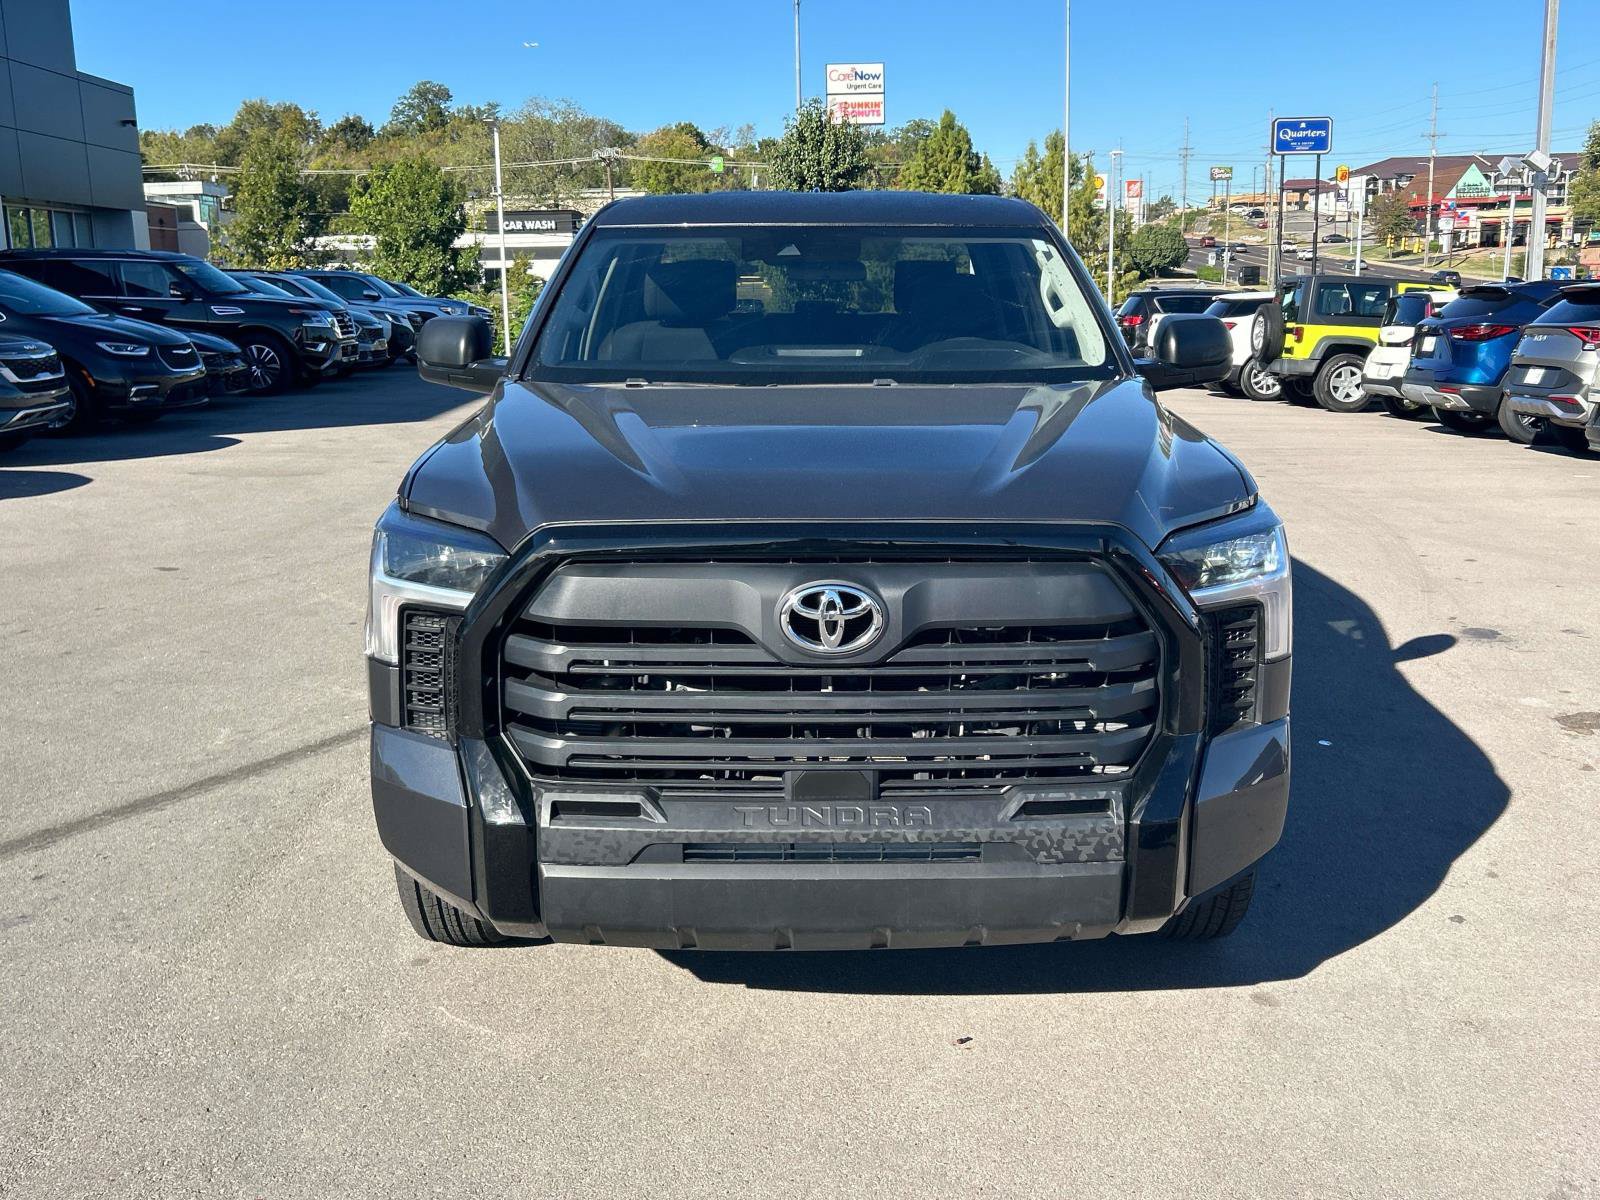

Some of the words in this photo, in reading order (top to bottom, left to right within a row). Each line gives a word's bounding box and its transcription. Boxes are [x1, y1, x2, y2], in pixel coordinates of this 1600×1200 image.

[829, 69, 882, 81] CareNow
[1280, 128, 1327, 140] Quarters
[503, 221, 523, 230] CAR
[524, 220, 556, 230] WASH
[734, 806, 932, 826] TUNDRA
